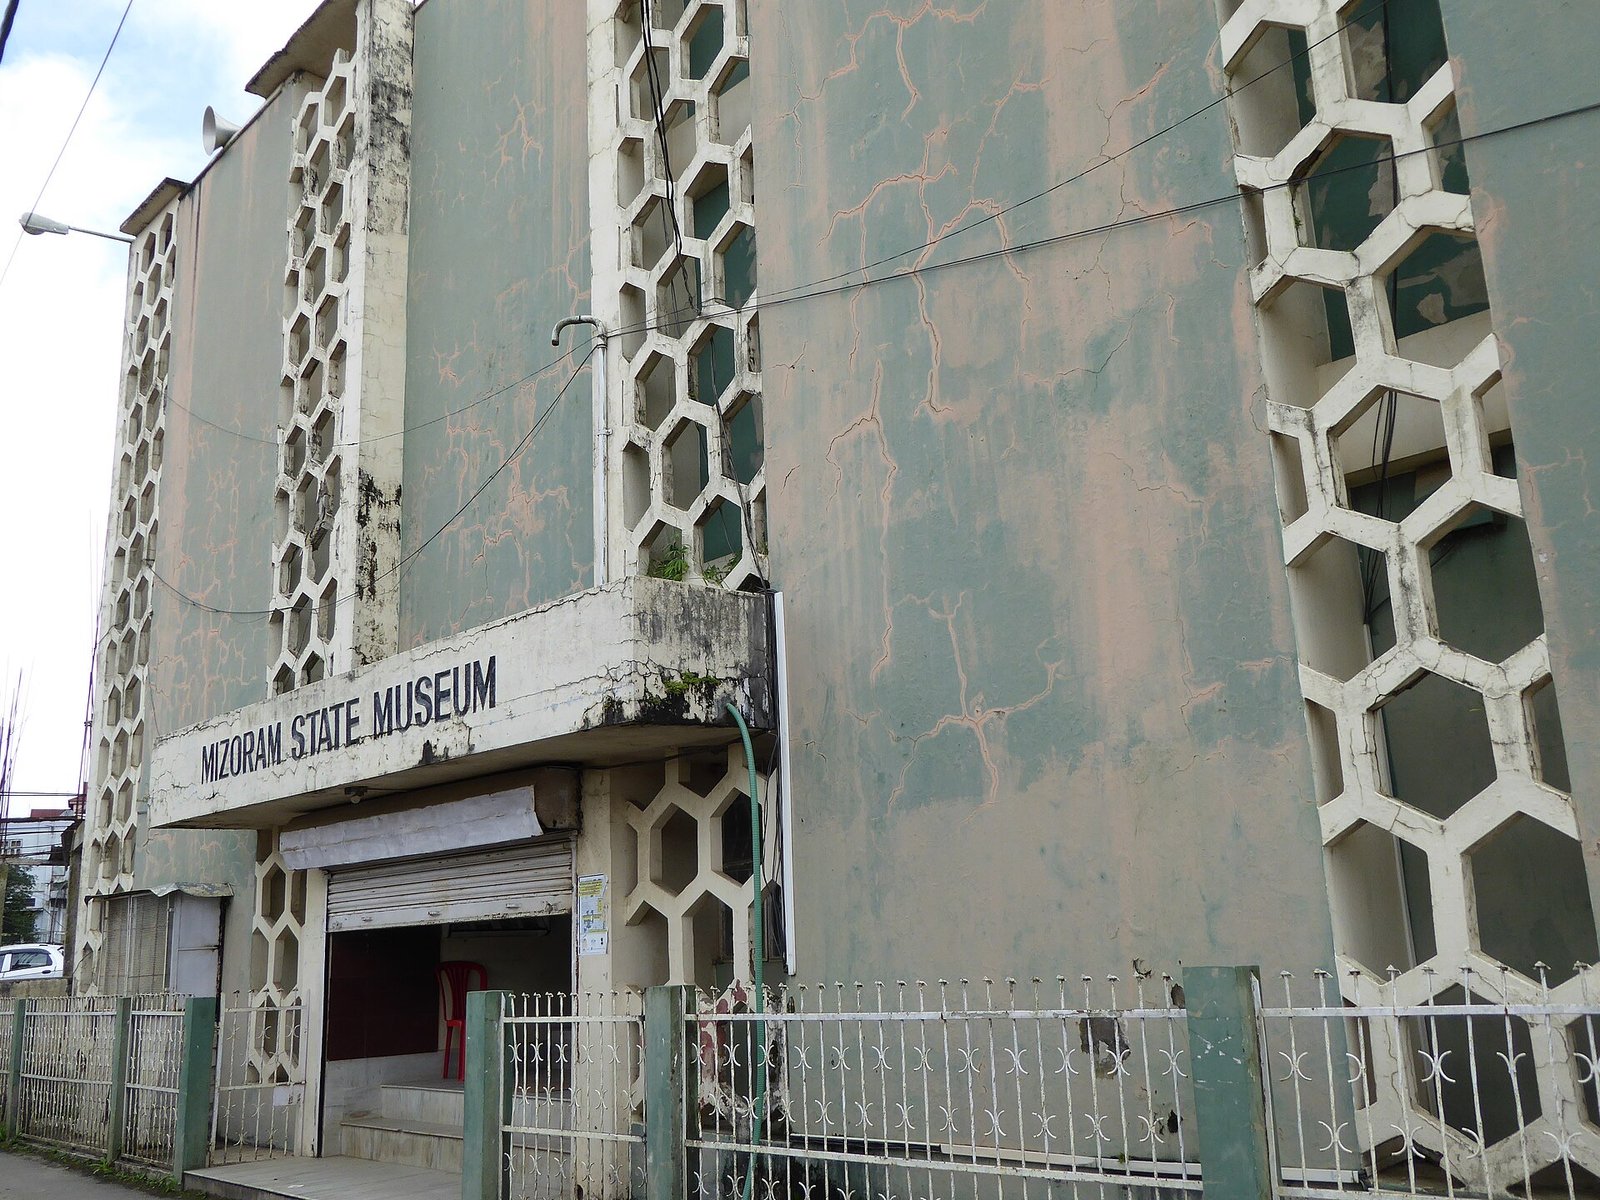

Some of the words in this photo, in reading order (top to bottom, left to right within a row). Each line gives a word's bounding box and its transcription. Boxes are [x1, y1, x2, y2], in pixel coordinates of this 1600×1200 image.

[201, 721, 282, 785] MIZORAM
[290, 697, 361, 761] STATE
[373, 655, 496, 741] MUSEUM
